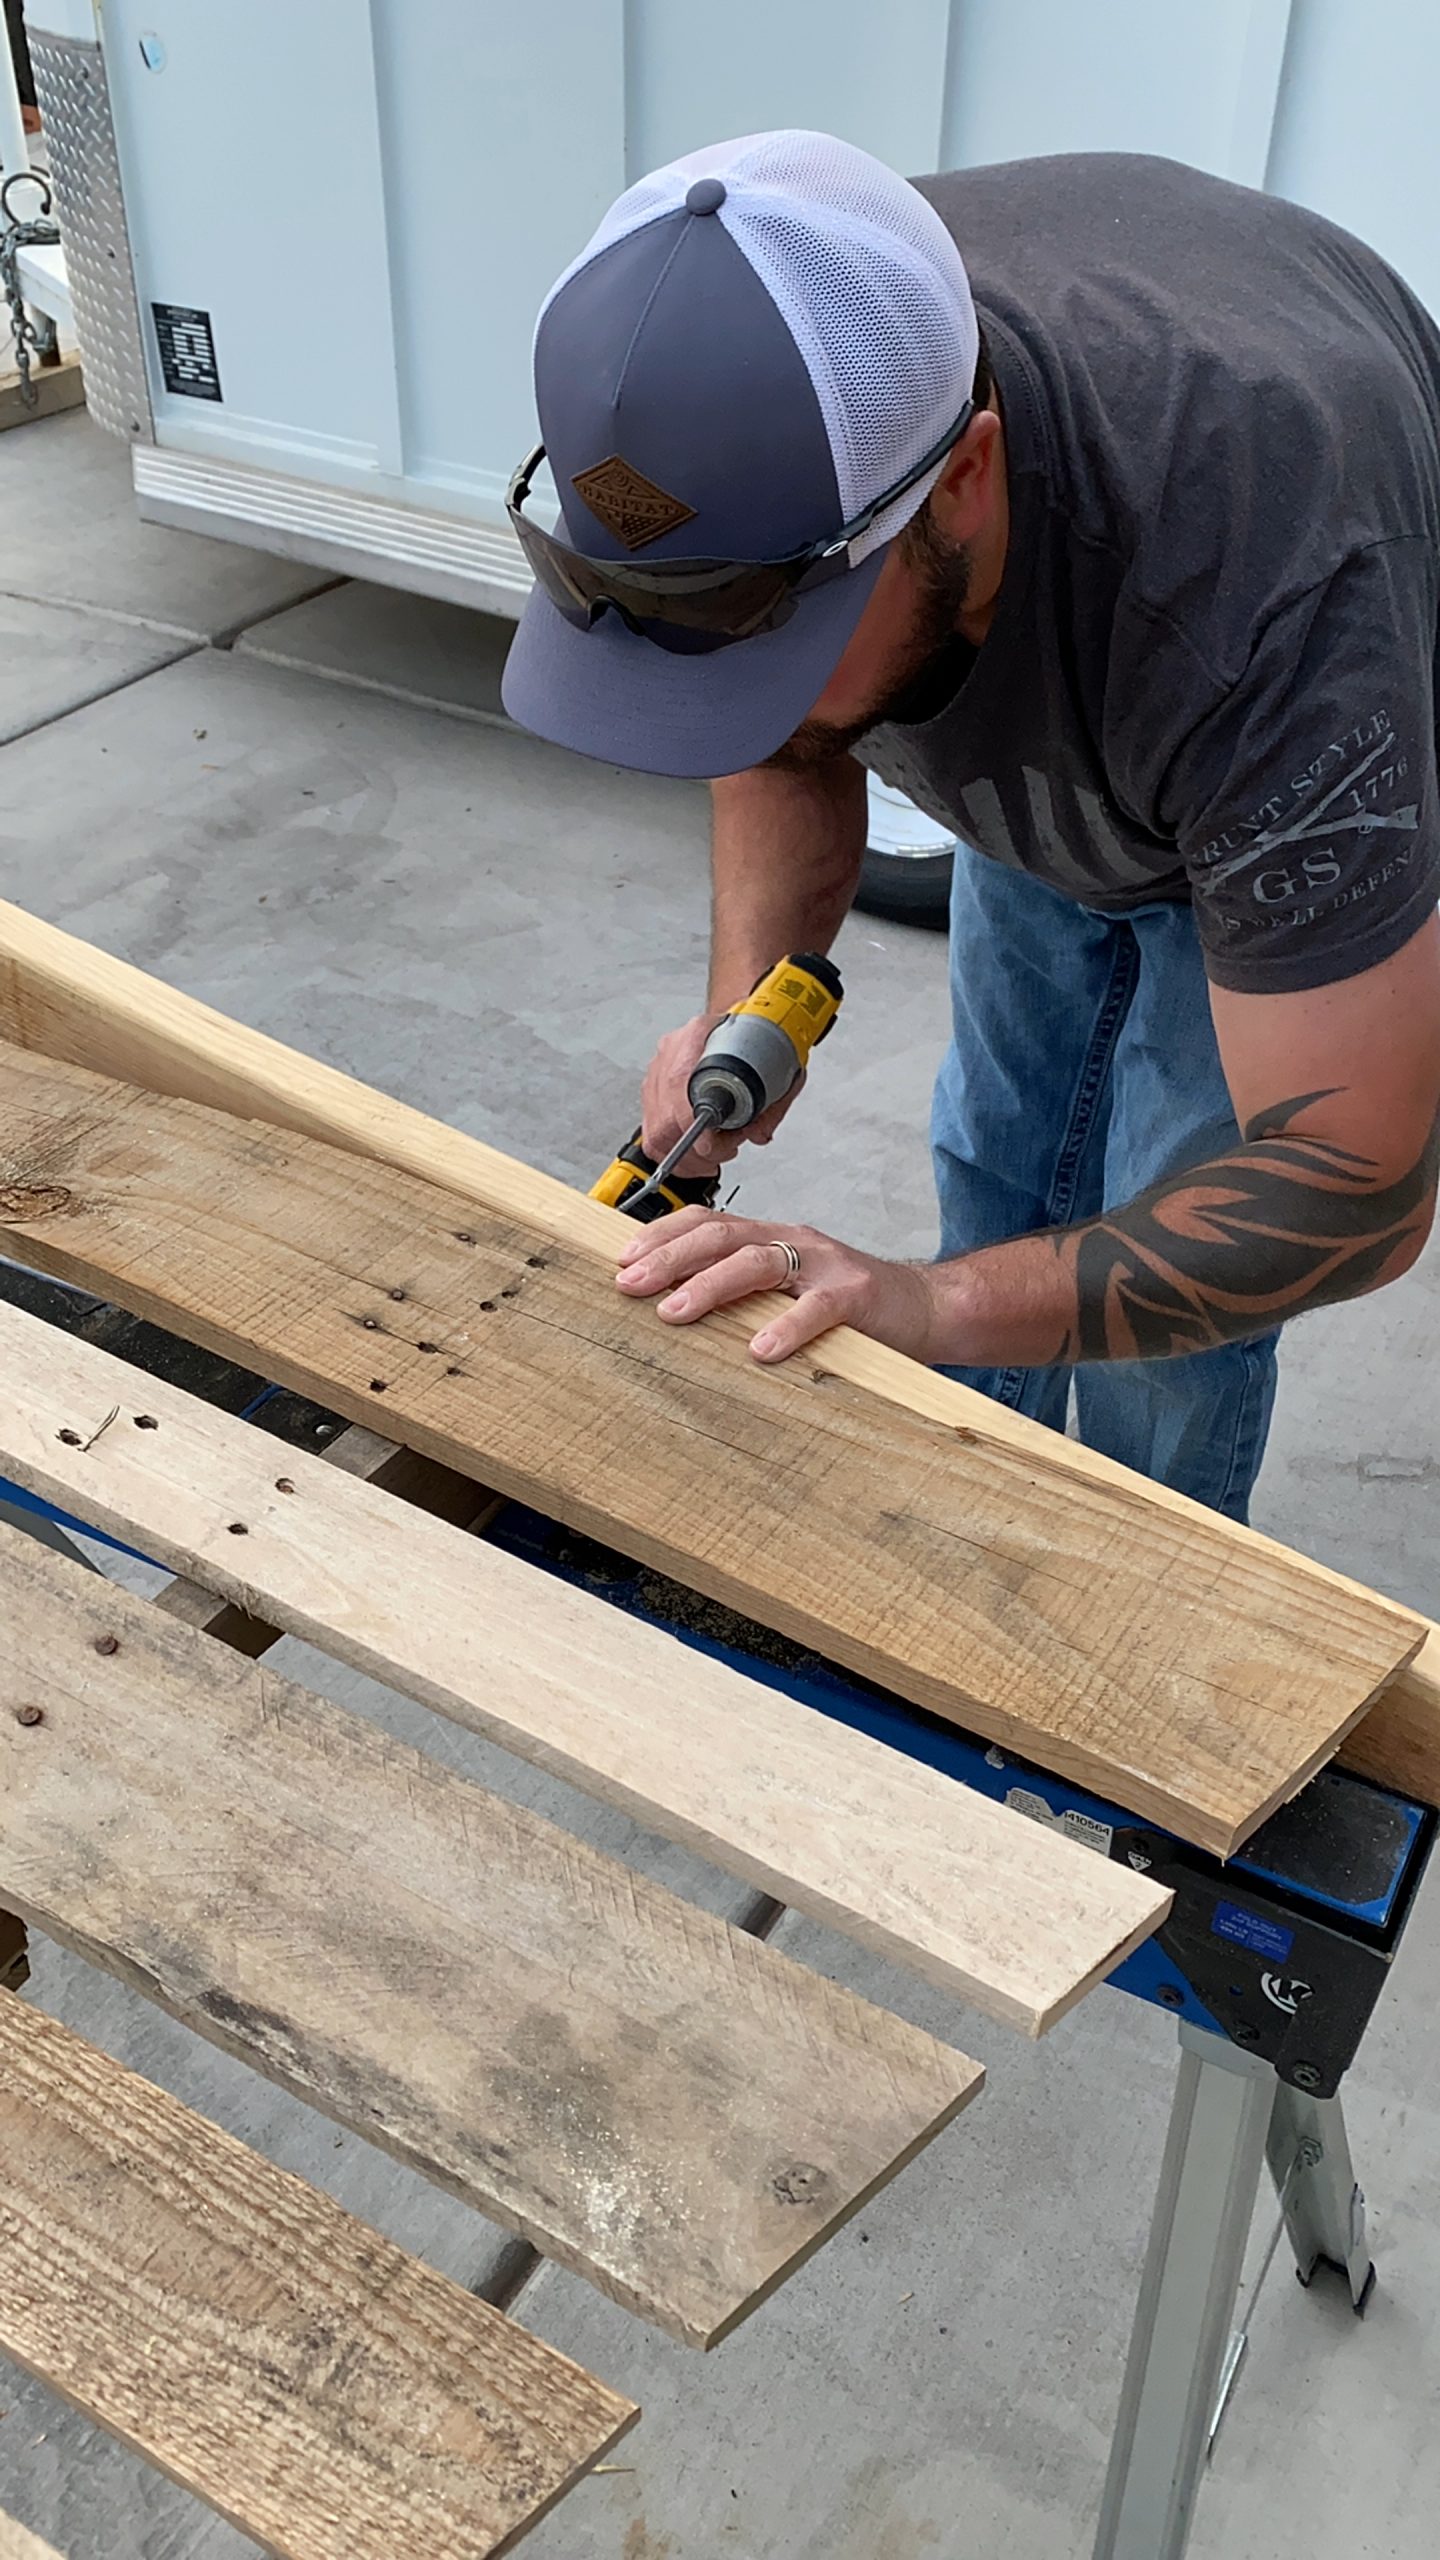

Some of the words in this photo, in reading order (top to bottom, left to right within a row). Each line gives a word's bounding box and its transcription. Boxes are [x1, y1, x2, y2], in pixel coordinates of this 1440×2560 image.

[582, 485, 678, 516] HABITAT
[1291, 709, 1391, 797] STYLE
[1349, 757, 1408, 811] 1776
[1253, 848, 1342, 903] GS
